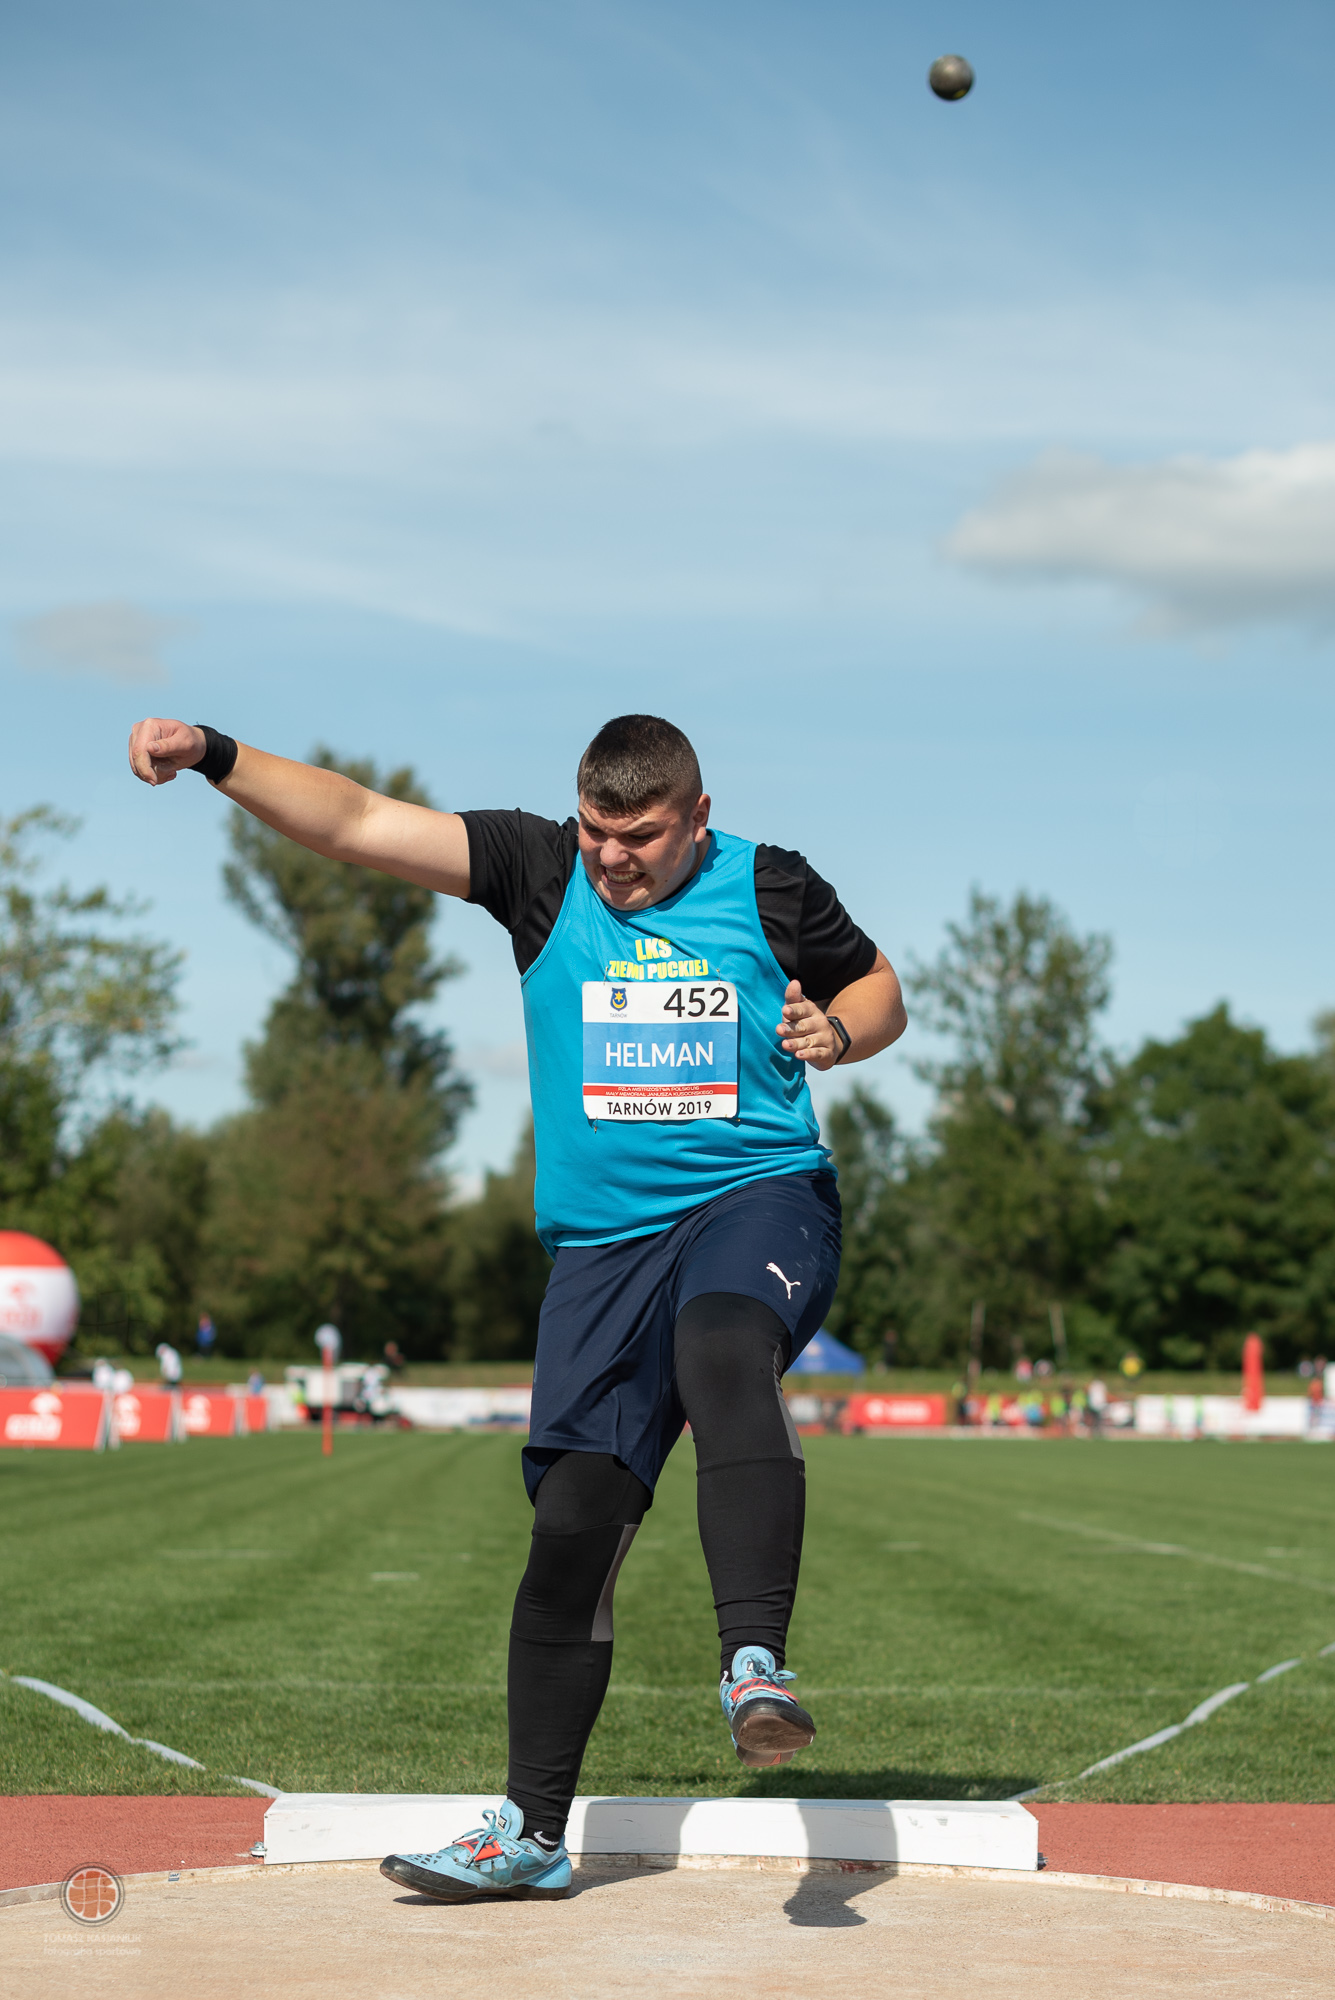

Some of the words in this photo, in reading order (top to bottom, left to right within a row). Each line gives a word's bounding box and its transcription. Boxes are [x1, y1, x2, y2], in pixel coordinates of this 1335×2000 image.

[635, 937, 672, 961] LKS
[608, 960, 644, 980] ZIEMI
[647, 959, 709, 980] PUCKIEJ
[663, 986, 730, 1018] 452
[605, 1041, 714, 1067] HELMAN
[607, 1099, 672, 1116] TARNÓW
[678, 1101, 712, 1115] 2019
